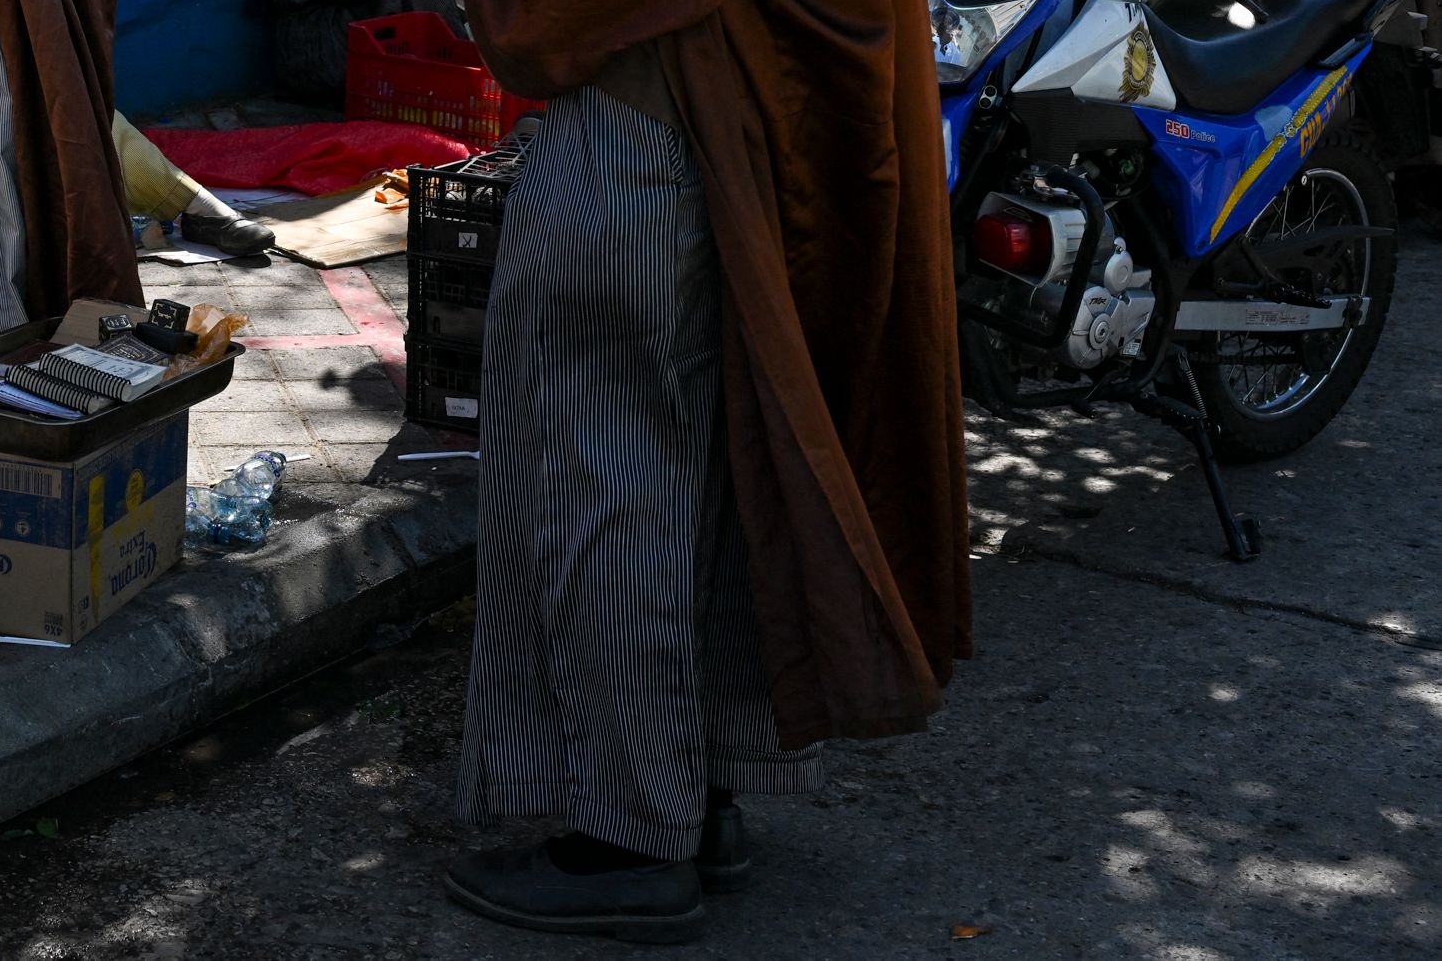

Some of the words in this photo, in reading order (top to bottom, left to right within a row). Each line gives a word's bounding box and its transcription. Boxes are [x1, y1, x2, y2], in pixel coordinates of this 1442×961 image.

[1166, 119, 1190, 139] 250
[119, 530, 145, 558] Extra
[110, 542, 157, 596] Corona
